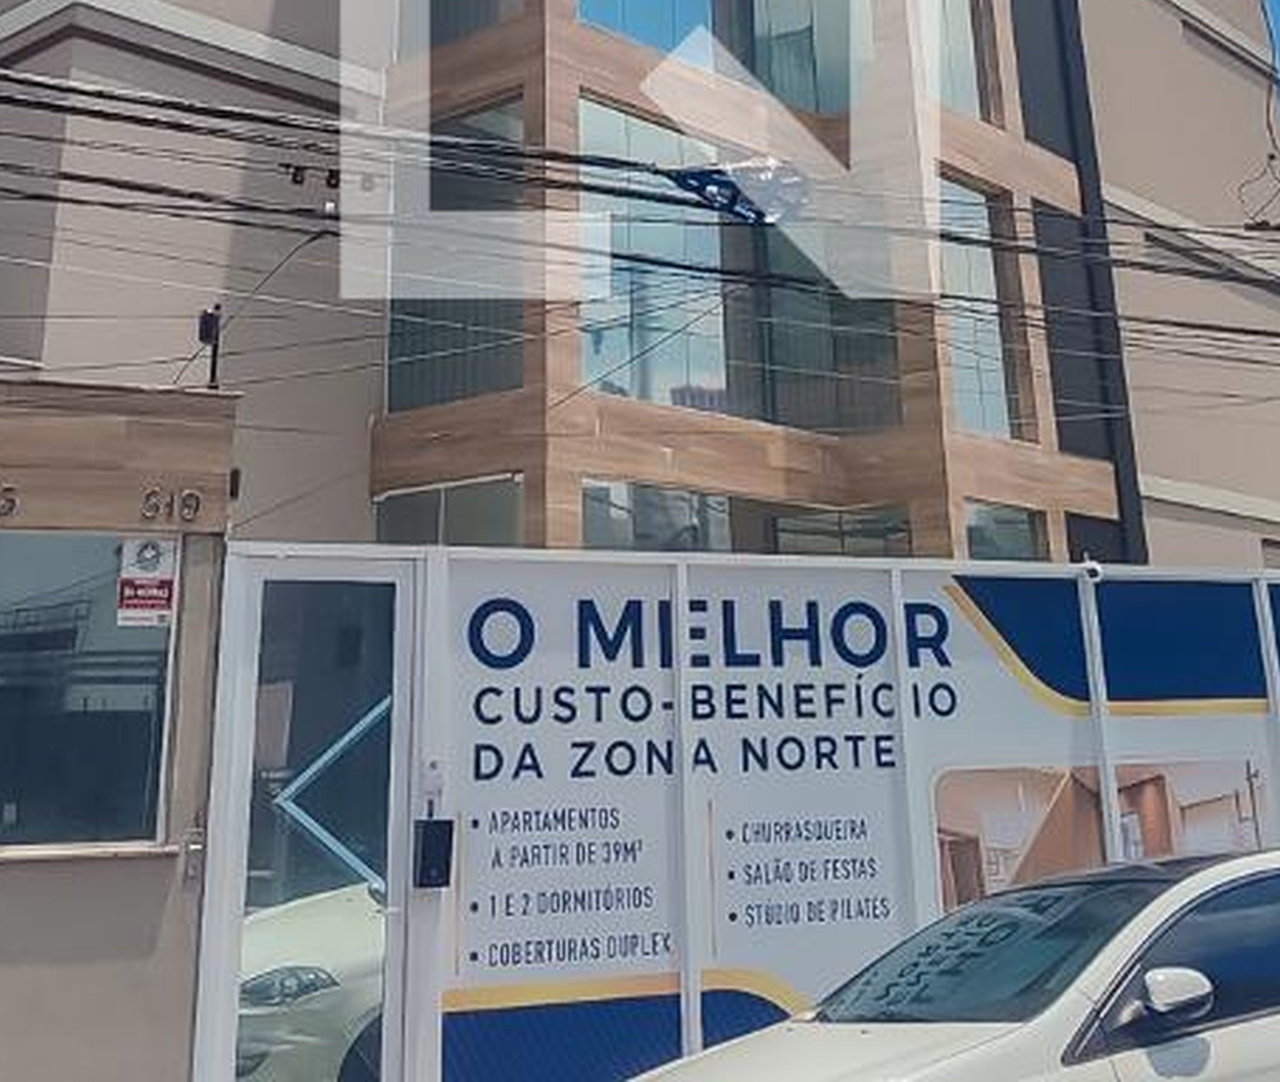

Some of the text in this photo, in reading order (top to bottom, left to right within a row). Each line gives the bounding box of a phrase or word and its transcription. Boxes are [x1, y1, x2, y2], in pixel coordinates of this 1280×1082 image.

[467, 598, 953, 670] O MELHOR
[474, 674, 958, 725] CUSTO-BENEFÍCIO
[474, 735, 897, 780] DA ZONA NORTE
[489, 808, 620, 834] APARTAMENTOS
[742, 818, 868, 844] CHURRASQUEIRA
[492, 848, 502, 868] A
[510, 844, 569, 868] PARTIR
[576, 841, 596, 865] DE
[744, 857, 878, 885] SALÃO DE FESTAS
[490, 885, 654, 917] 1 E 2 DORMITÓRIOS
[807, 901, 825, 923] DE
[831, 897, 890, 922] PILATES
[488, 932, 672, 966] COBERTURAS DUPLEX
